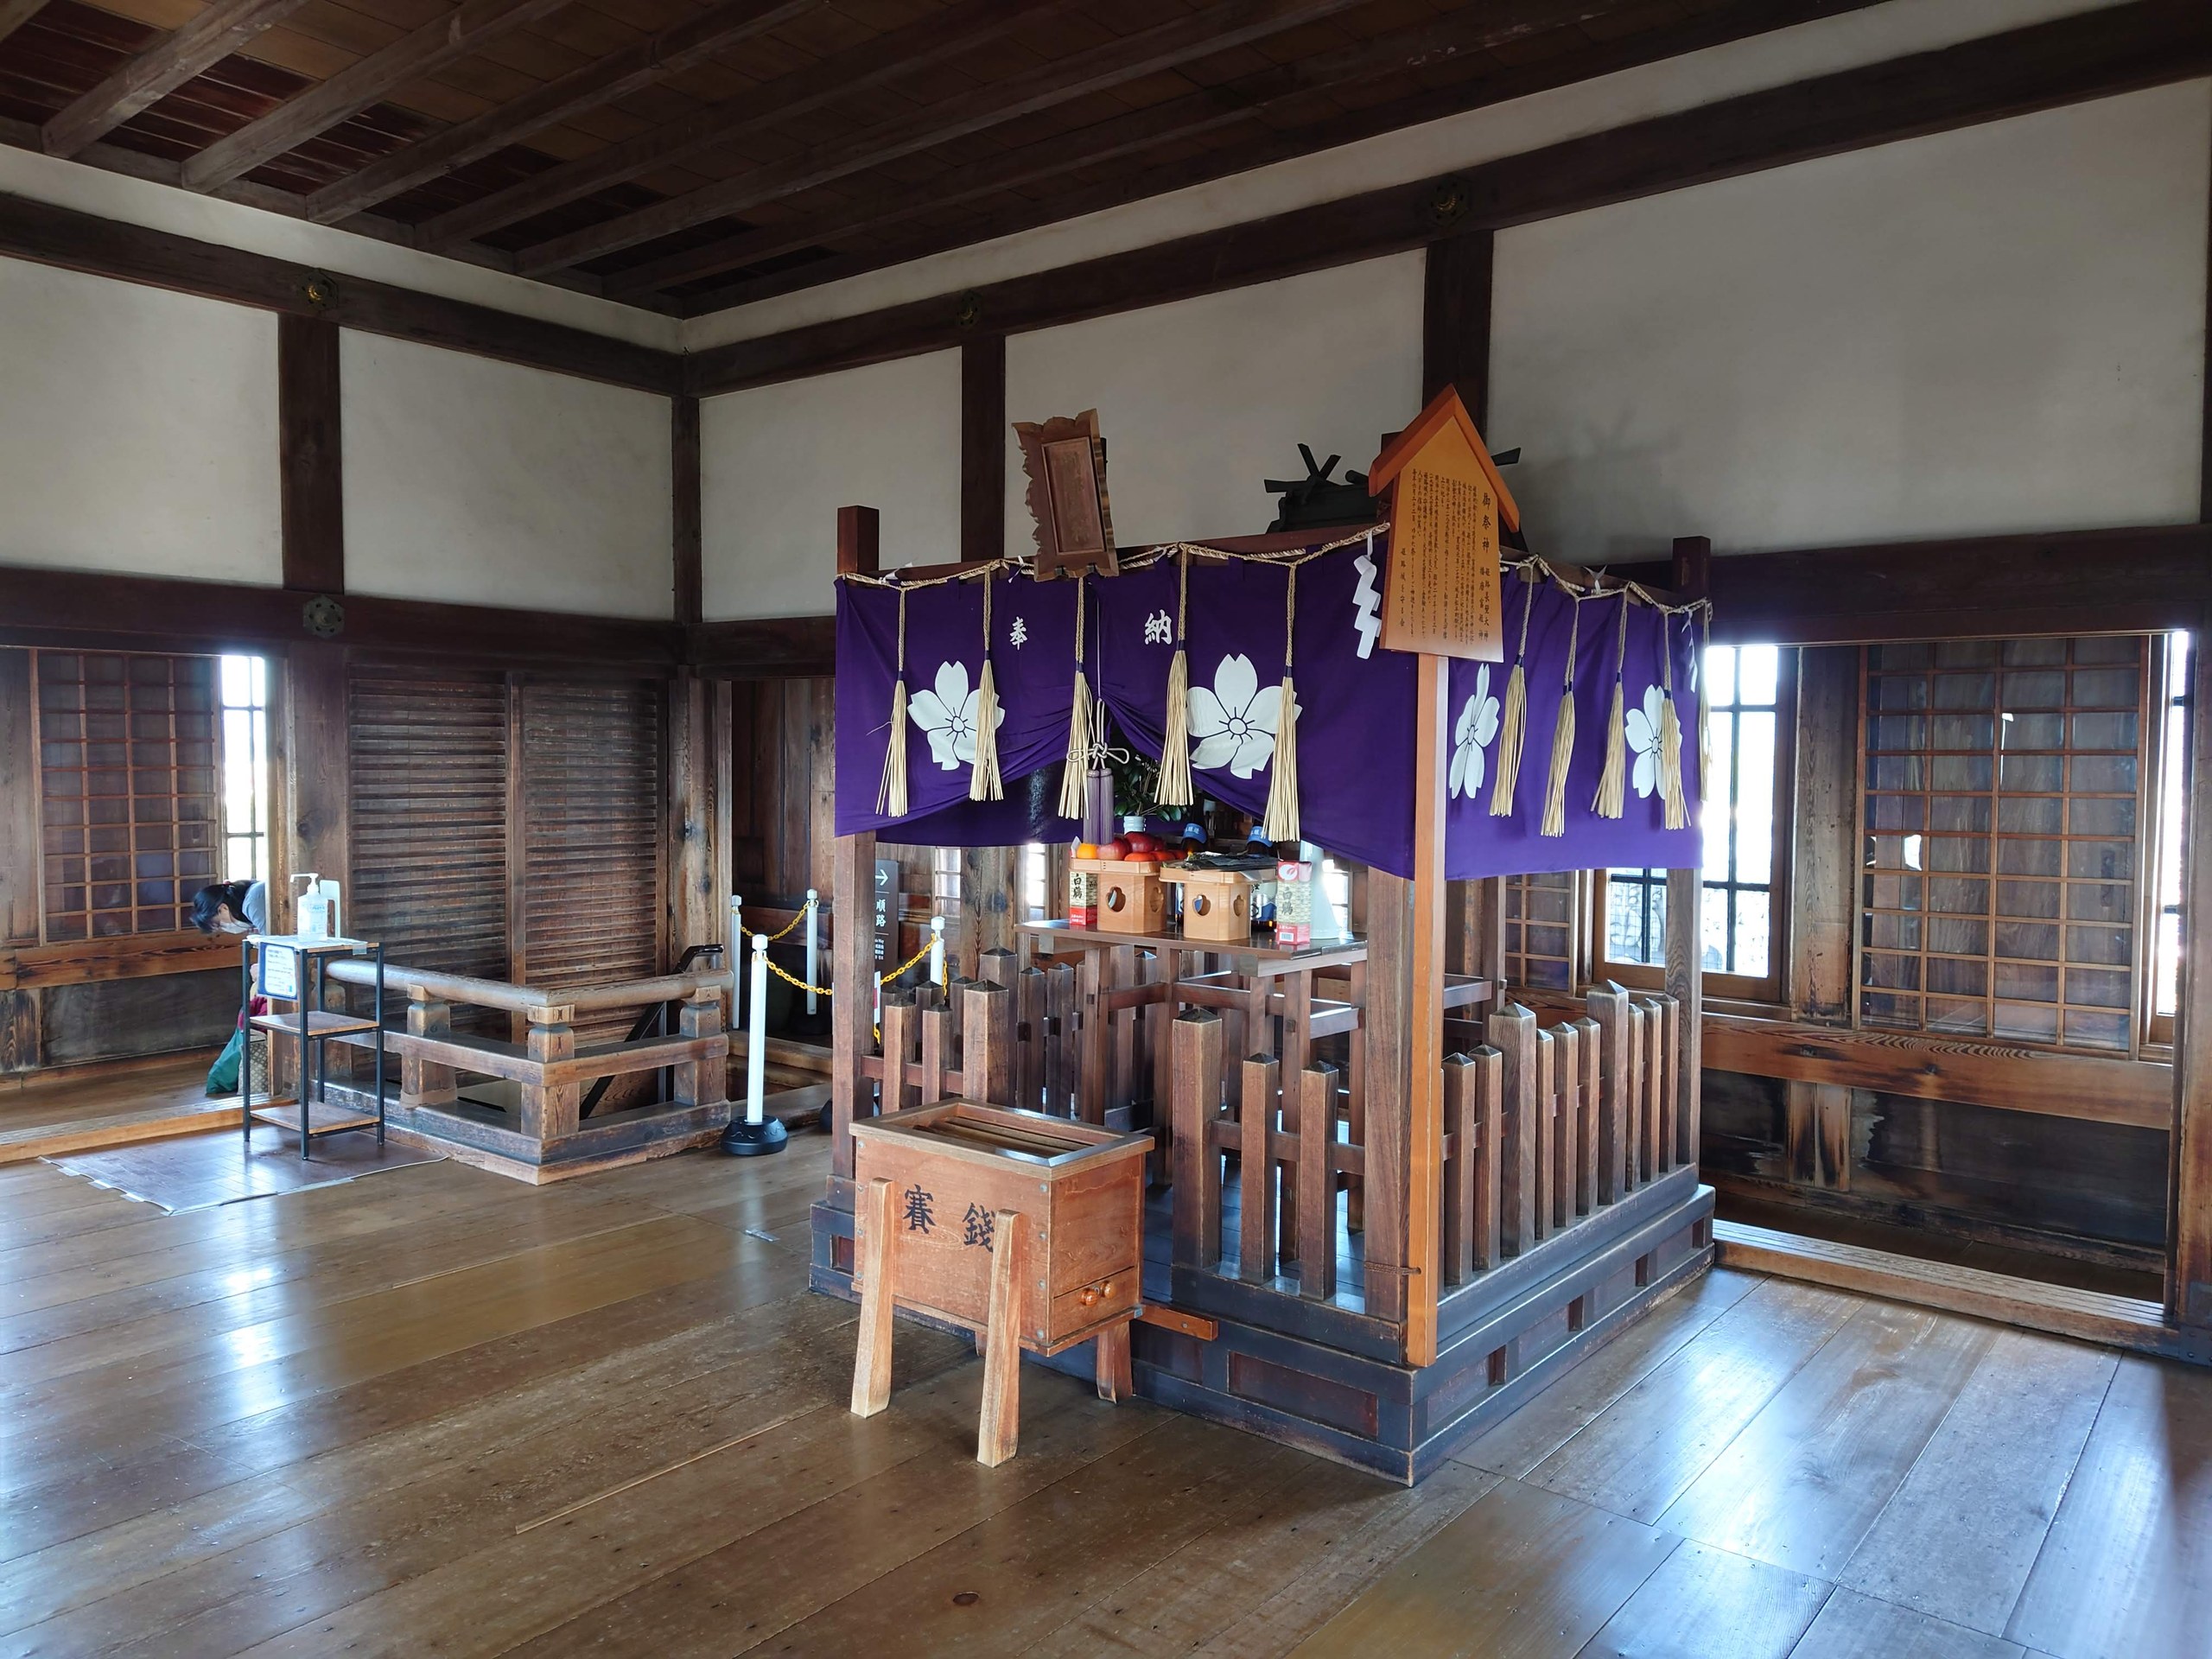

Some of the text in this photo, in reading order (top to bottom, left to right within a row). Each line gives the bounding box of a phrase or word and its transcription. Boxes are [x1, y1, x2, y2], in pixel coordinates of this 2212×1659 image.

[1009, 608, 1173, 651] 奉 納
[1072, 873, 1083, 899] 白鶴
[875, 899, 887, 927] 順路
